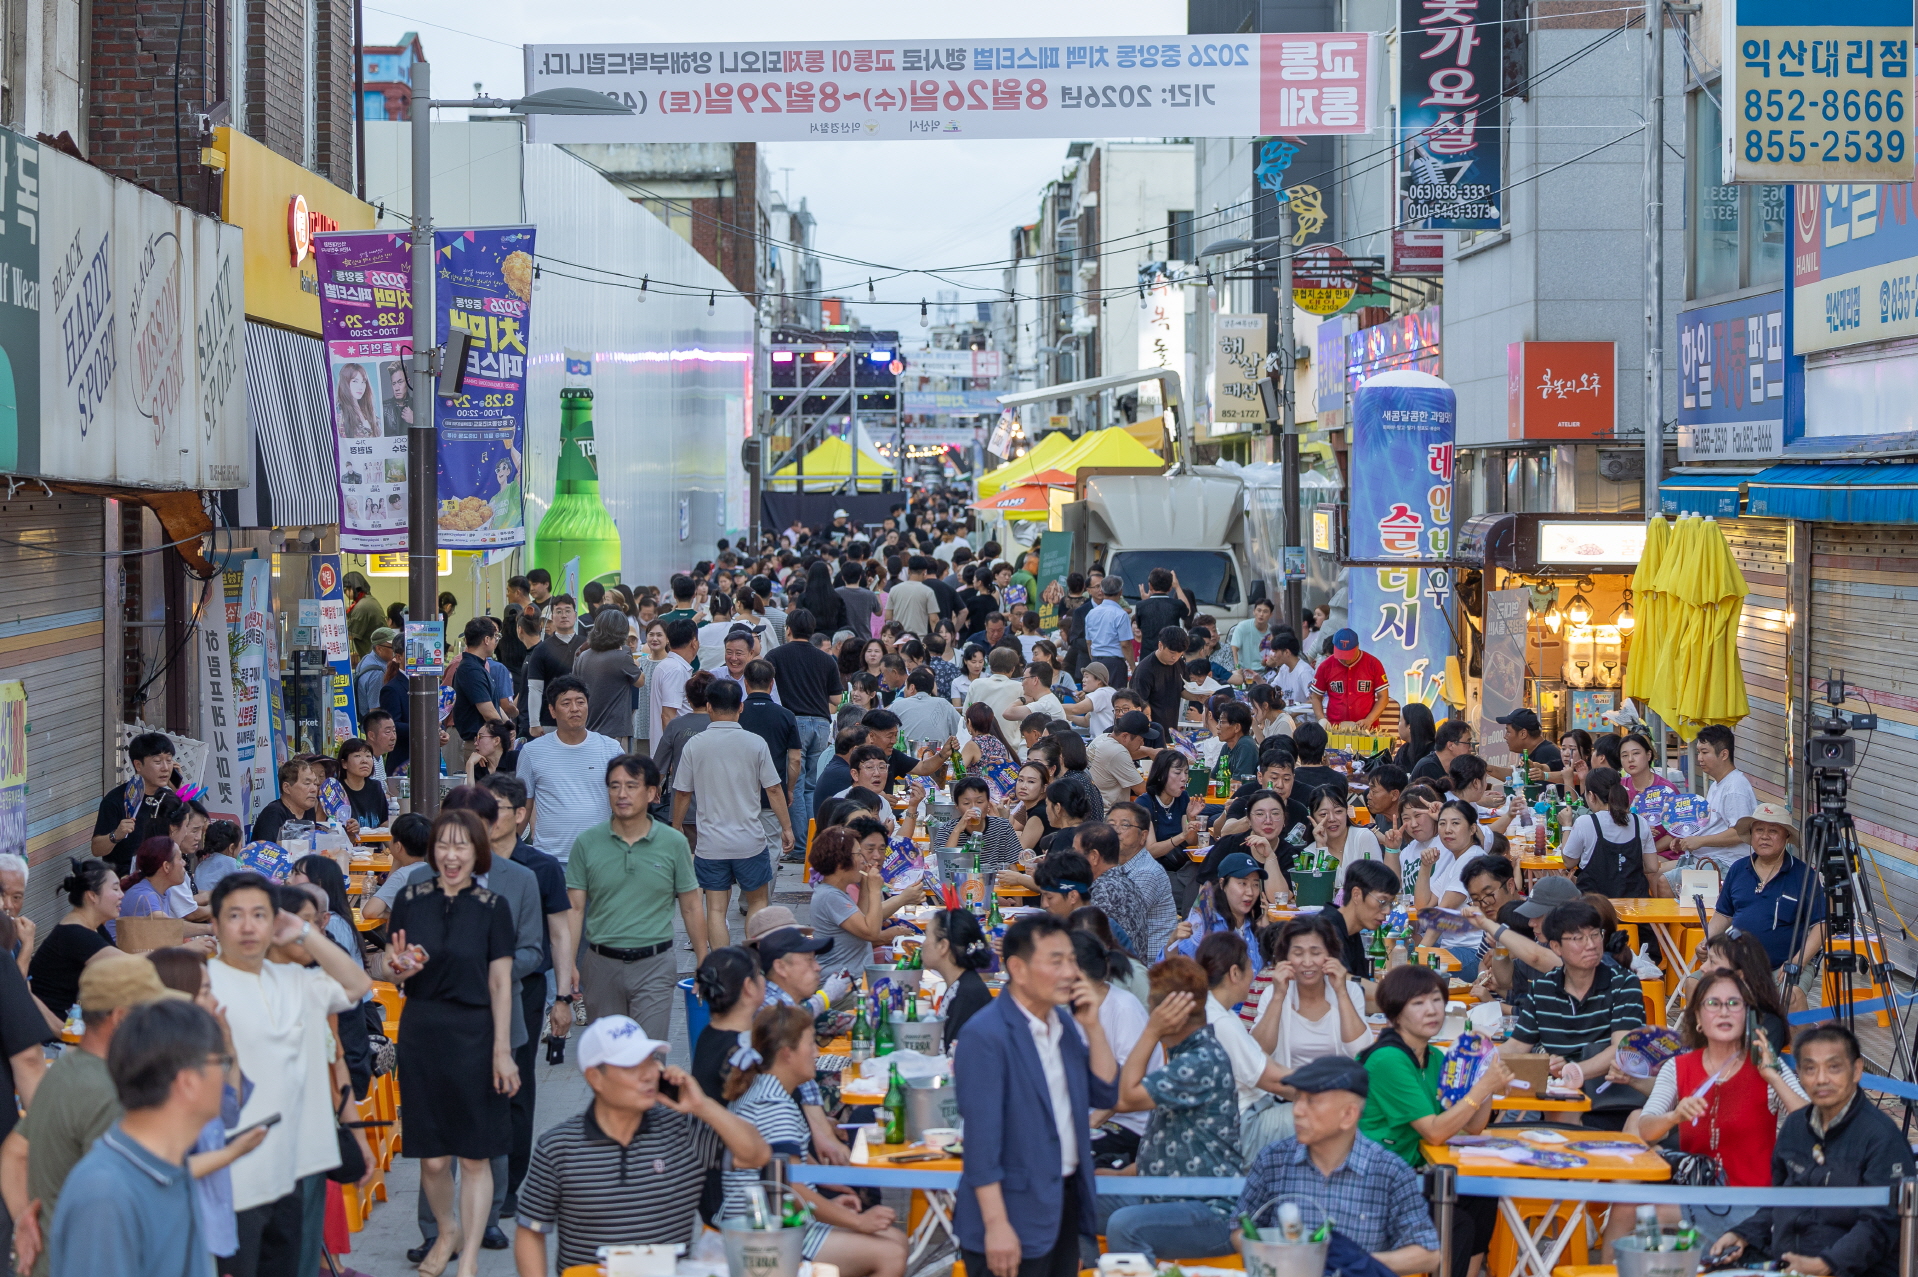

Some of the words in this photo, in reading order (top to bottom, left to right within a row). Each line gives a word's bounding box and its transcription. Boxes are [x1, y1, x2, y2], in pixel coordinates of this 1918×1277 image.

[1742, 38, 1908, 79] 익산대리점
[1744, 88, 1905, 123] 852-8666
[1744, 129, 1906, 164] 855-2539
[1409, 183, 1492, 201] 063)858-3331
[53, 227, 84, 316] BLACK
[130, 231, 156, 338] BLACK
[1795, 251, 1820, 277] HANIL
[13, 264, 41, 313] Wear
[62, 229, 113, 389] HARDY
[1825, 284, 1861, 333] 익산대리점
[198, 253, 233, 387] SAINT
[78, 312, 118, 443] SPORT
[1218, 335, 1264, 379] 햇살
[151, 334, 187, 451] SPORT
[203, 323, 238, 446] SPORT
[1222, 380, 1260, 401] 패션
[1576, 372, 1602, 398] 오후
[1221, 409, 1260, 418] 852-1727
[1381, 409, 1429, 423] 새콤달콤한
[1429, 410, 1453, 424] 과일맛!
[1371, 502, 1425, 651] 슬러시
[1340, 640, 1350, 649] T
[1246, 858, 1254, 866] C
